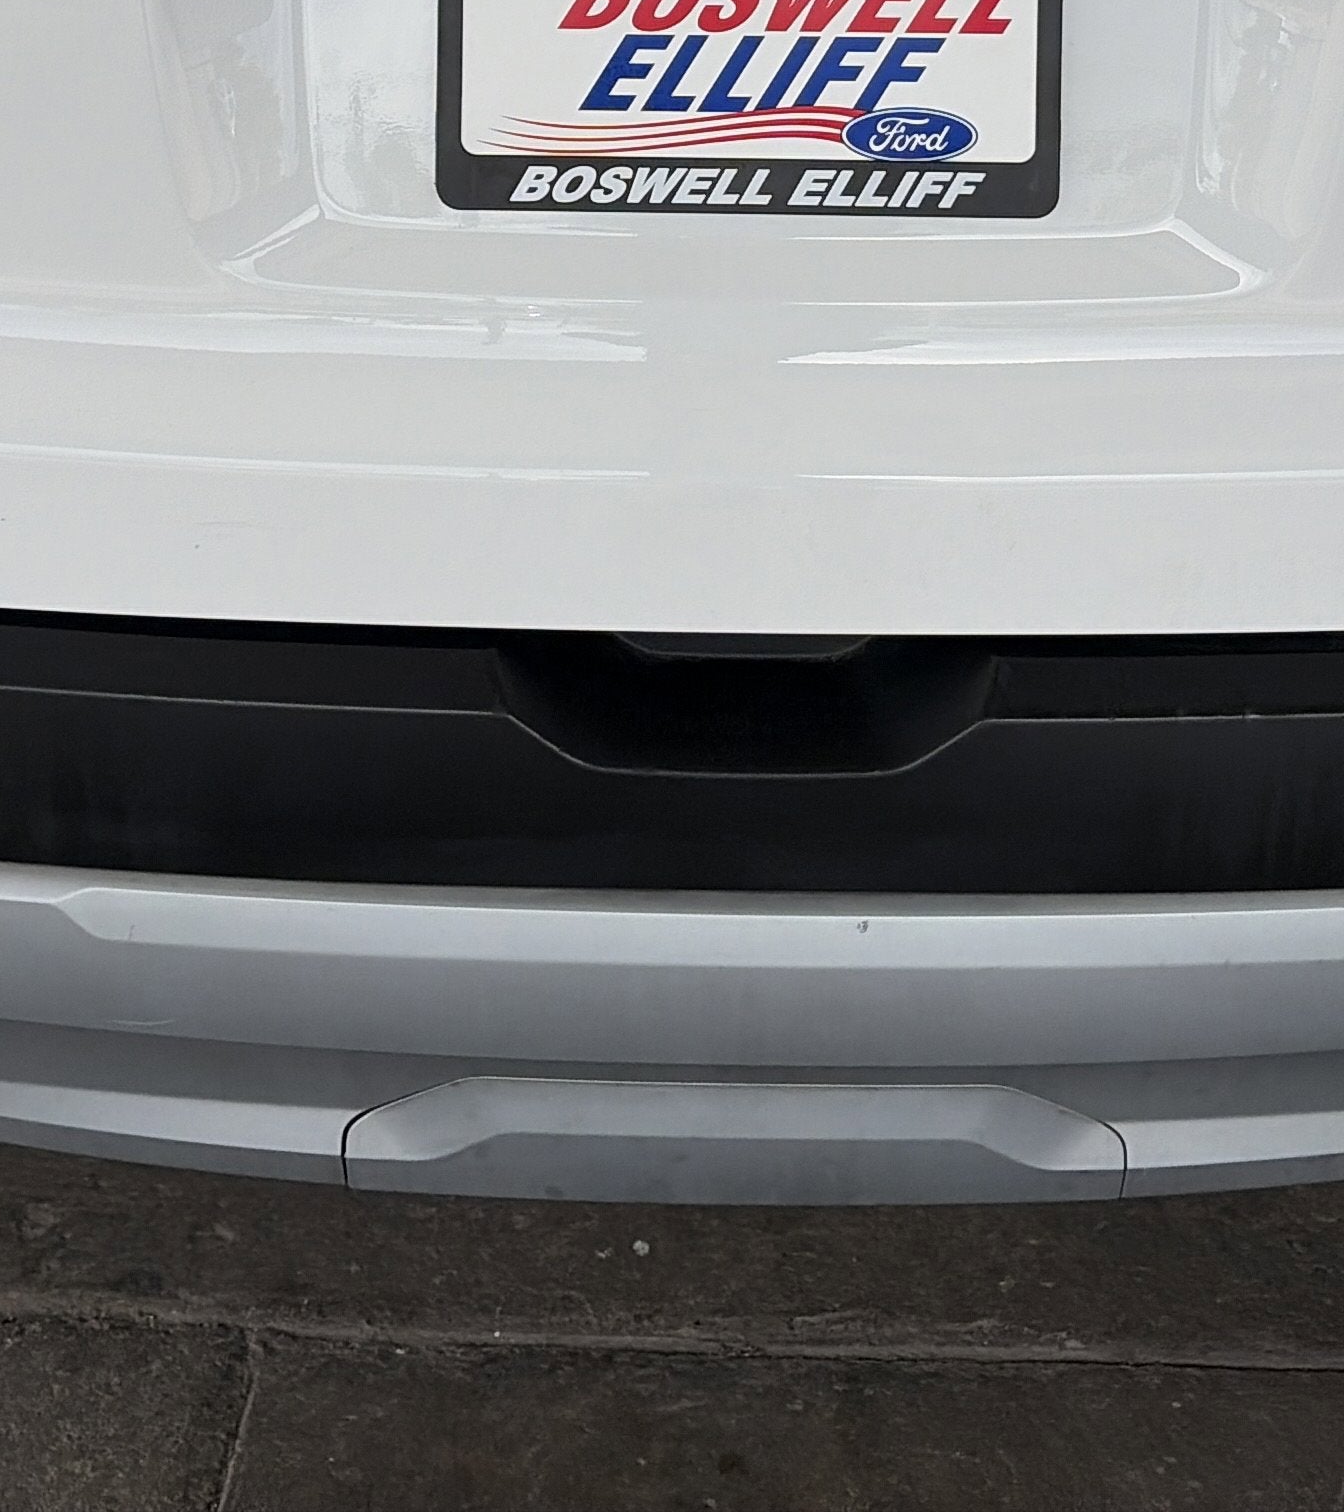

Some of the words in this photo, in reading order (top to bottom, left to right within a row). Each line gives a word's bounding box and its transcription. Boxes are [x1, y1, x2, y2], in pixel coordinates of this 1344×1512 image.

[578, 34, 947, 113] ELLIFF
[868, 116, 951, 152] Ford
[509, 164, 776, 207] BOSWELL
[787, 169, 987, 209] ELLIFF
